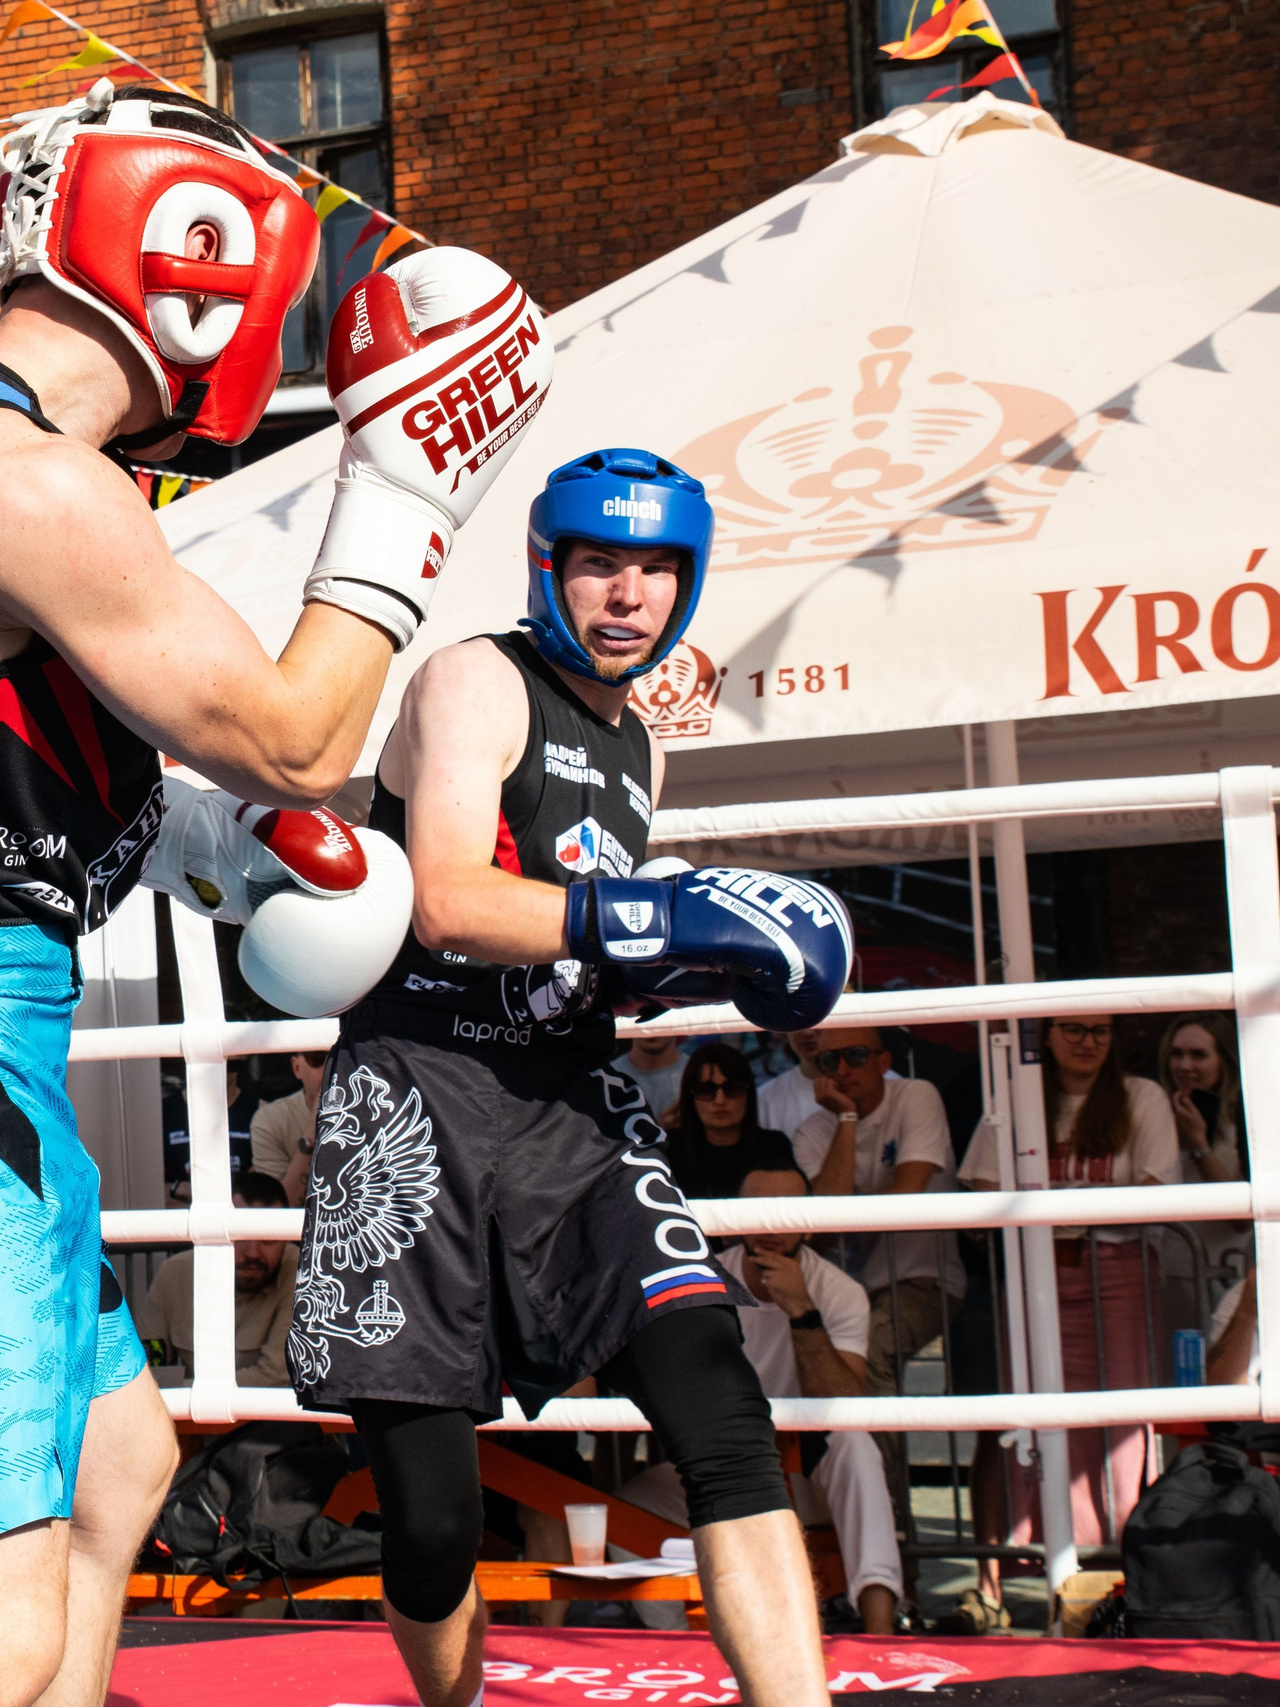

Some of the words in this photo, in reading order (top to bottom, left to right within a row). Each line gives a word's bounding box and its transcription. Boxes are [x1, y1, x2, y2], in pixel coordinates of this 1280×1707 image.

[355, 287, 374, 349] UNIQUE
[401, 313, 541, 441] GREEN
[421, 369, 538, 476] HILL
[476, 449, 488, 466] BE
[487, 432, 509, 456] YOUR
[509, 413, 527, 437] BEST
[527, 400, 541, 419] SELF
[602, 496, 662, 521] clinch
[748, 662, 850, 698] 1581
[4, 854, 30, 867] GIN
[694, 868, 794, 928] HILL
[718, 895, 728, 904] BE
[730, 899, 750, 916] YOUR
[749, 911, 767, 927] BEST
[765, 923, 782, 938] SELF
[443, 950, 468, 964] GIN
[453, 1014, 532, 1046] laprad
[483, 1661, 949, 1692] BROM
[583, 1688, 737, 1704] GIN
